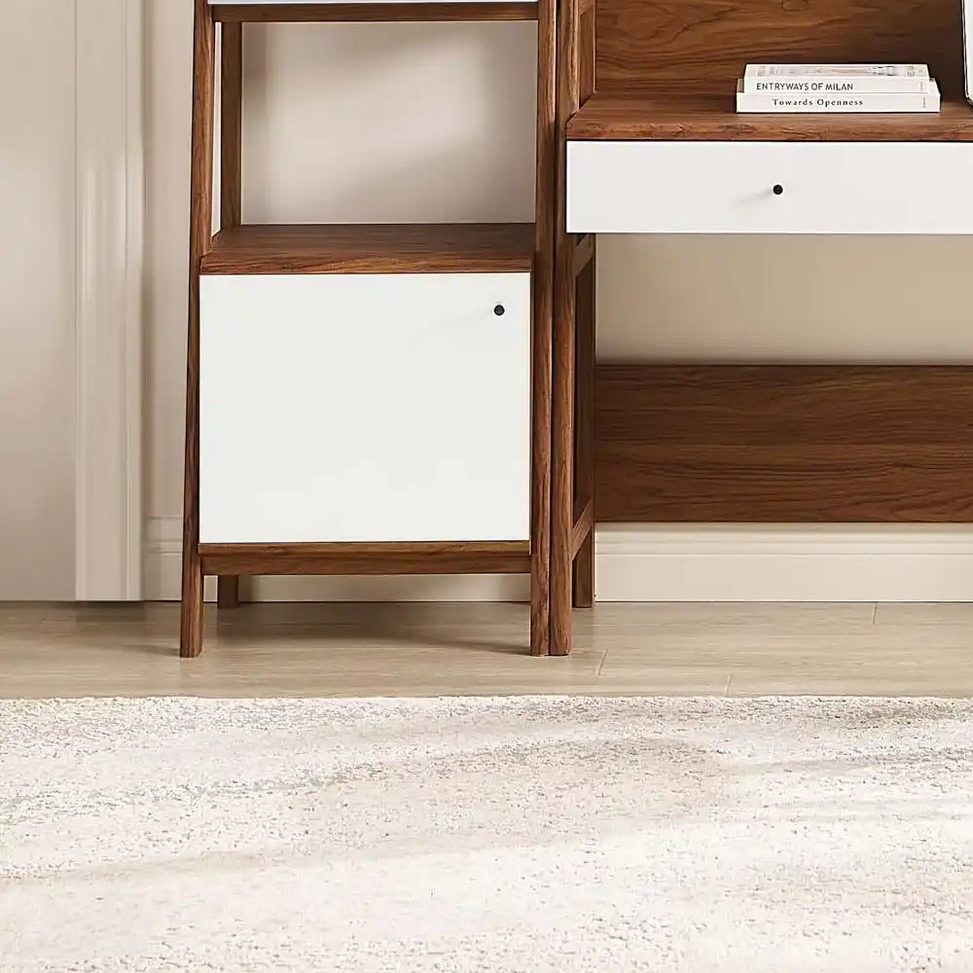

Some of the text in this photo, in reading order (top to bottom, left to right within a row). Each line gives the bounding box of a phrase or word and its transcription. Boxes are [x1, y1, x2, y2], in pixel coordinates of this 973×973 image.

[756, 82, 854, 91] ENTRYWAYS OF MILAN
[771, 98, 864, 108] Towards Openness
